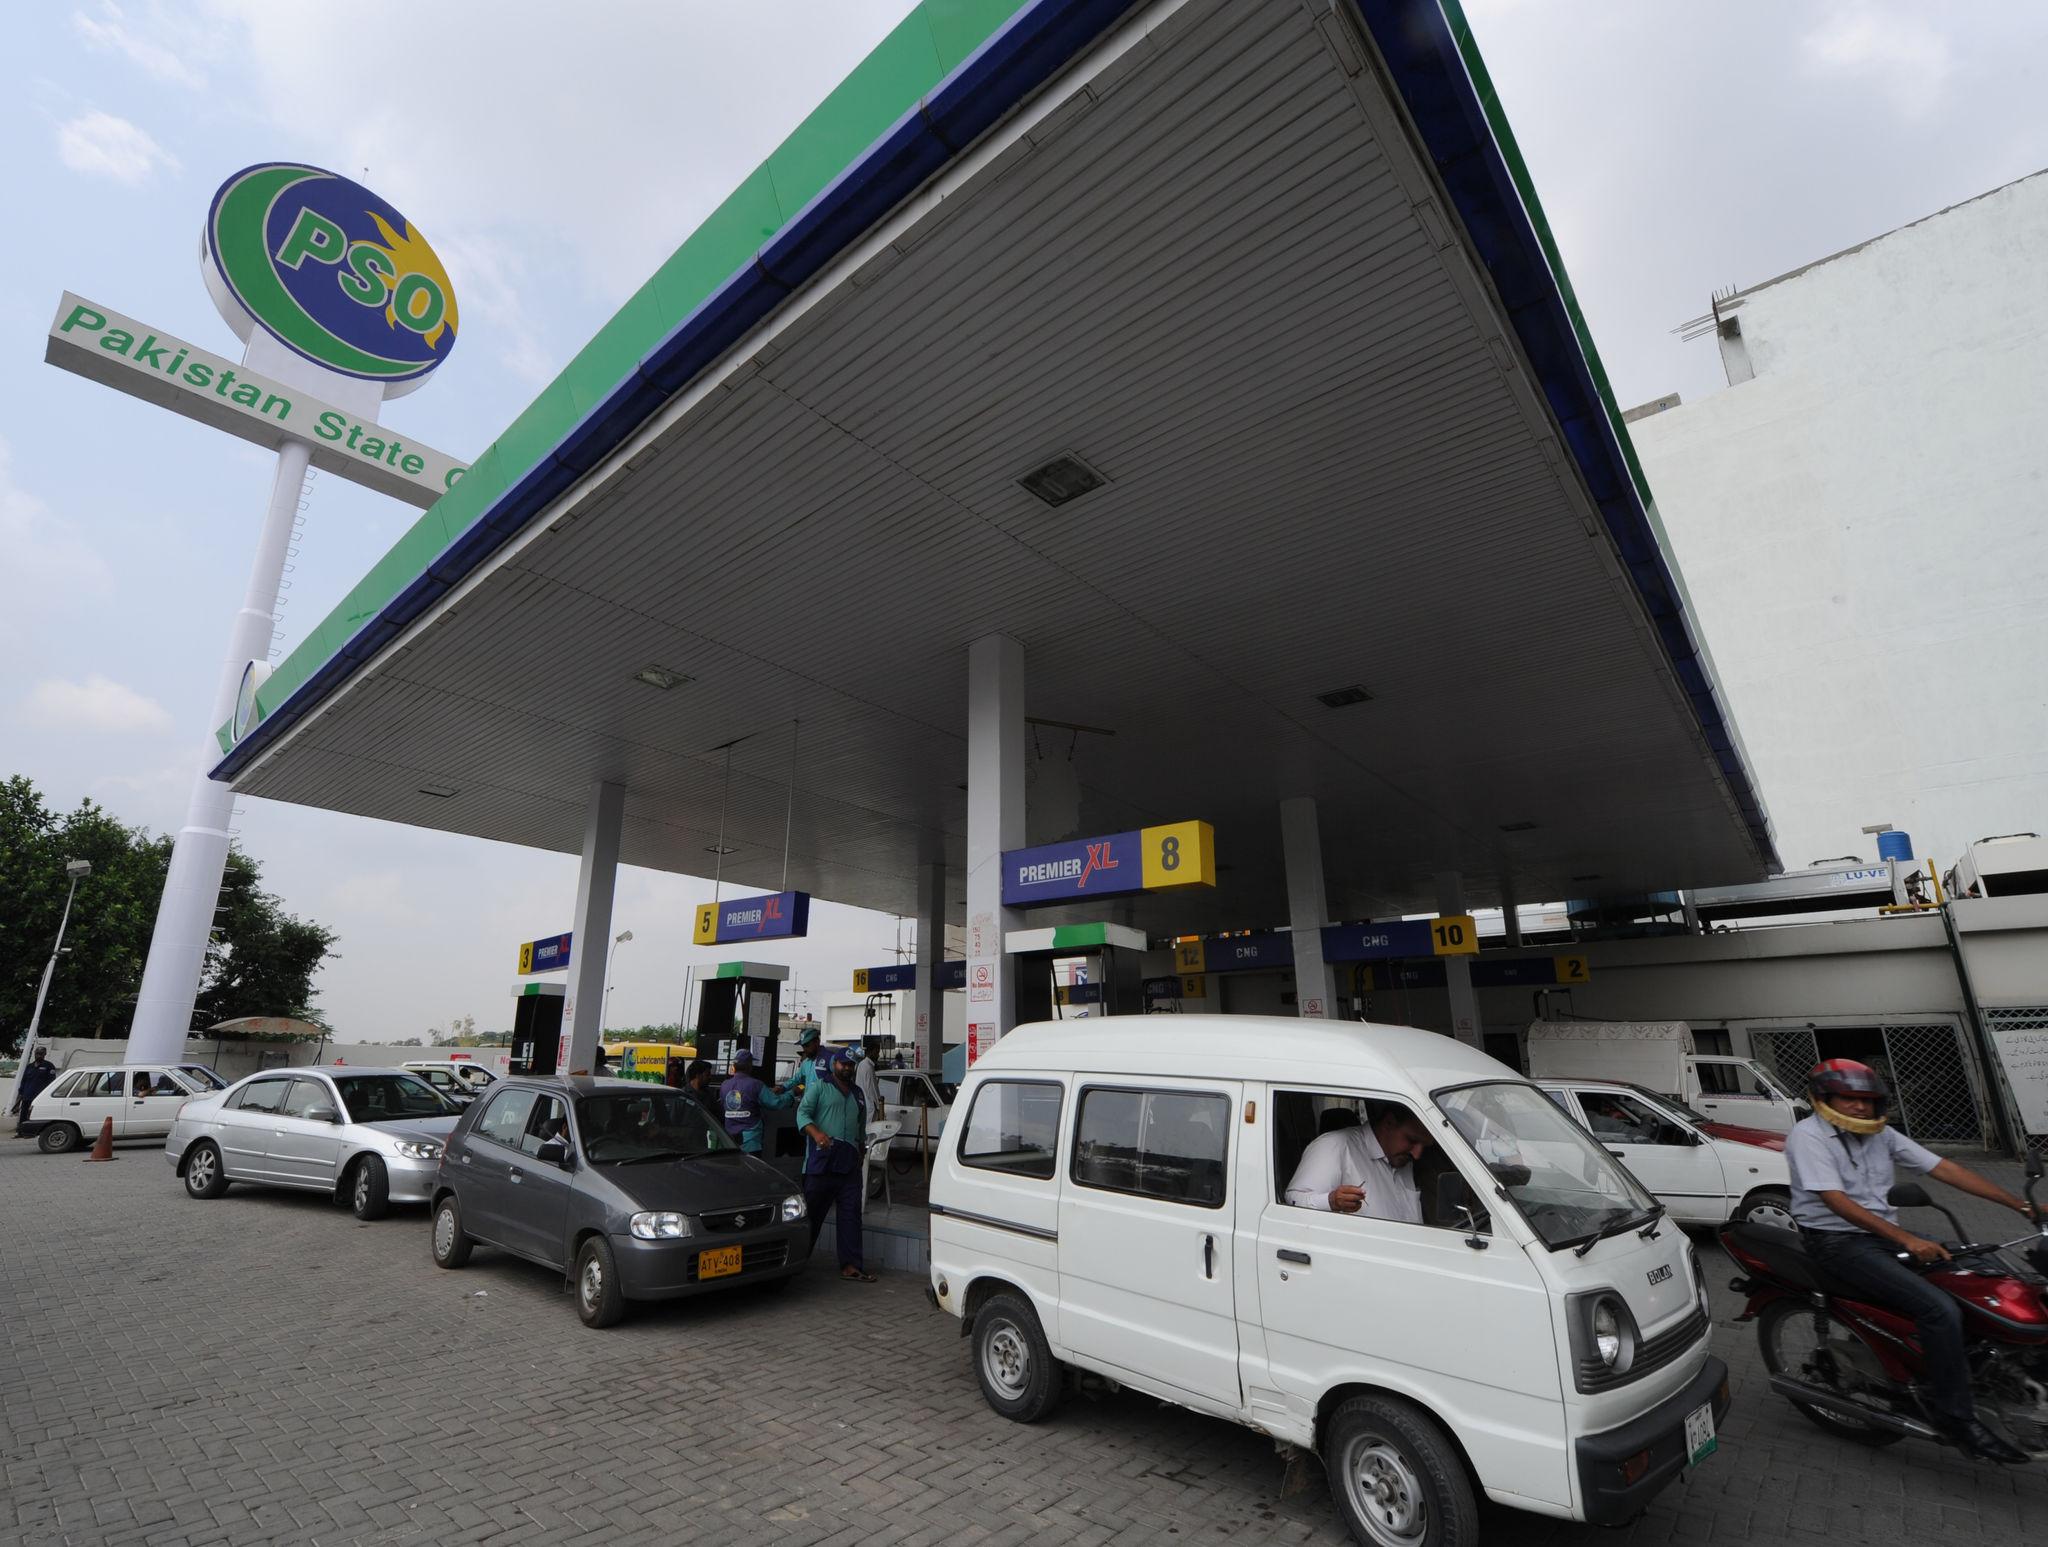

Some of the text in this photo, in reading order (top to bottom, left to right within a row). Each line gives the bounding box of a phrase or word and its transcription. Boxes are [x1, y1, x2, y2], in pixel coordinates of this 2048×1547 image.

[276, 205, 446, 334] PSO
[60, 304, 425, 475] Pakistan State
[1019, 835, 1180, 888] PREMIER XL 8
[1845, 869, 1886, 880] LU-VE
[702, 897, 783, 934] 5 PREMIER XL
[1362, 924, 1464, 947] CNG 10
[523, 948, 530, 968] 3
[1182, 946, 1258, 966] 12 CNG
[1568, 959, 1583, 977] 2
[855, 971, 898, 987] 16 CNG
[1147, 979, 1195, 994] CNG 5
[636, 1055, 666, 1065] Lubricants
[1647, 1265, 1671, 1285] BOLAN
